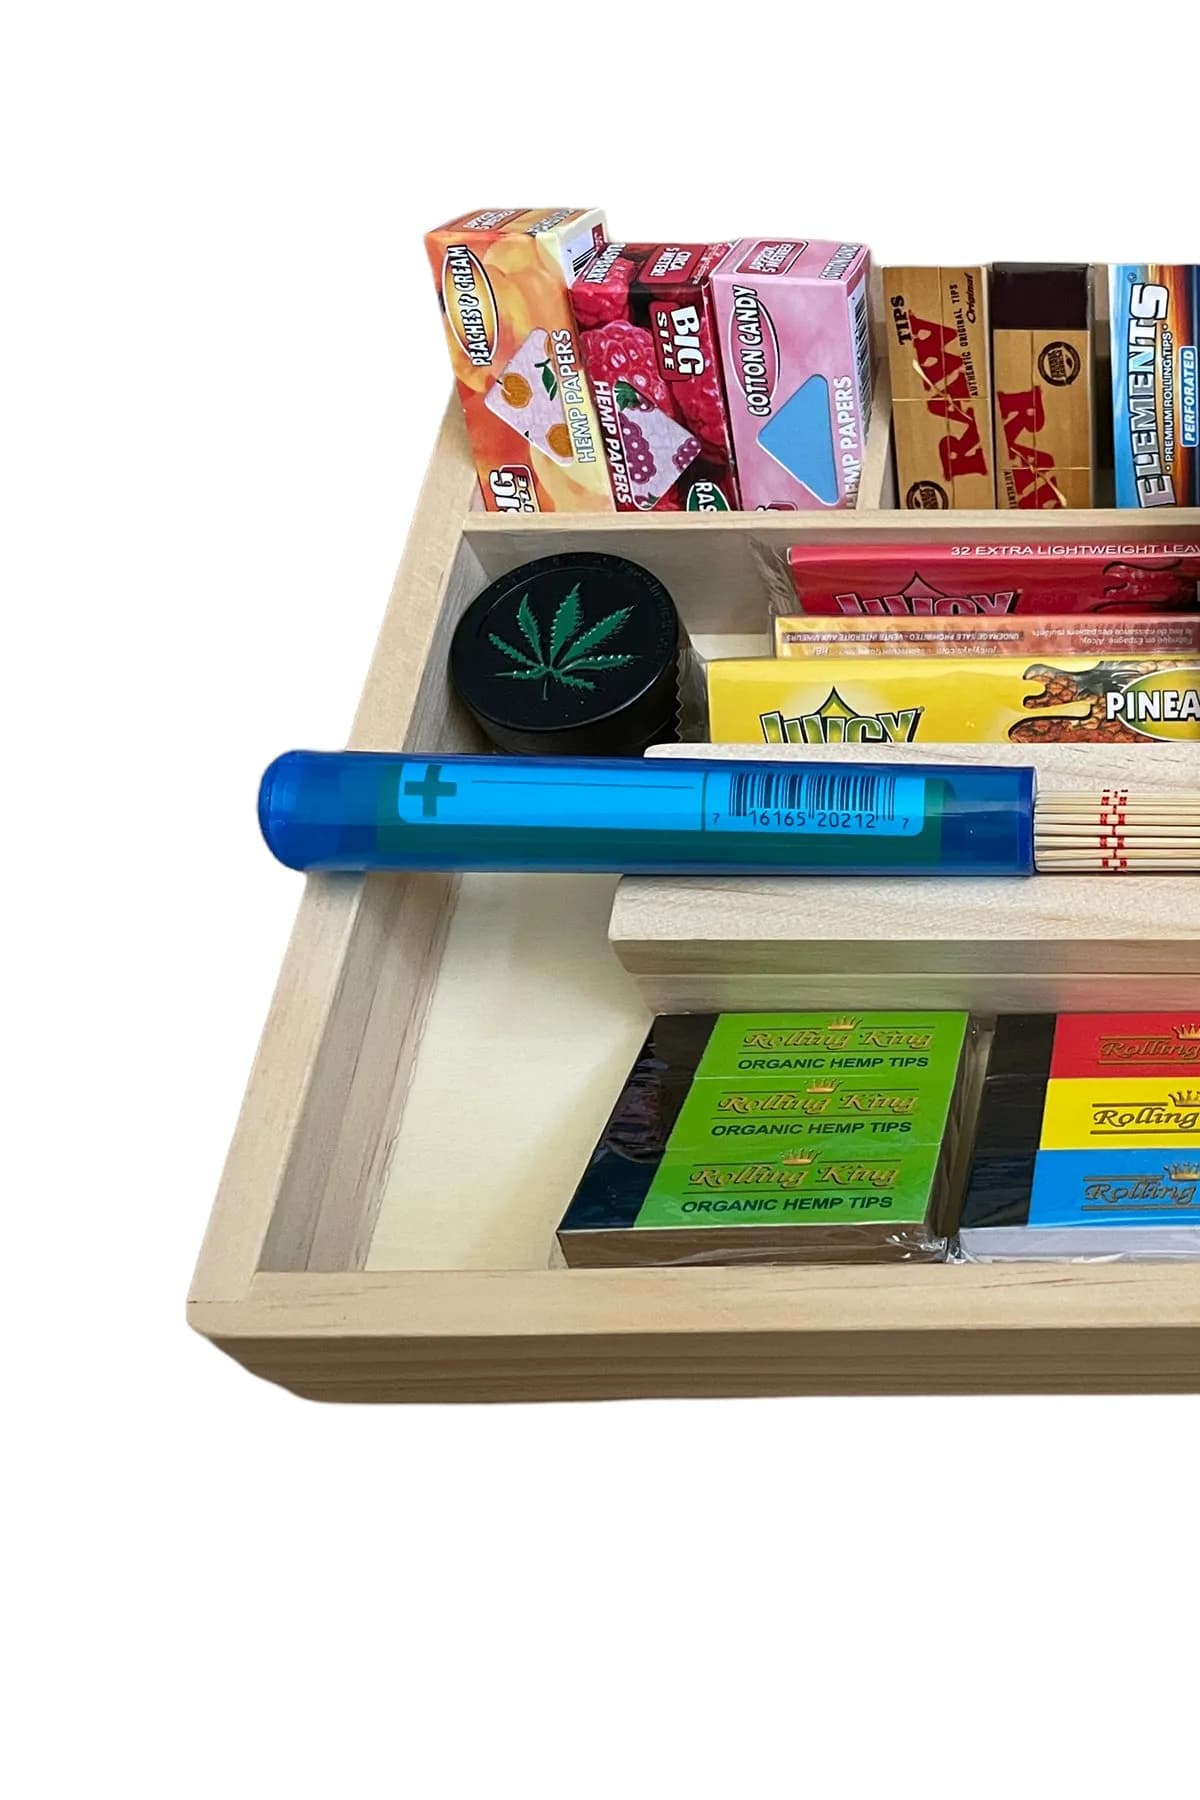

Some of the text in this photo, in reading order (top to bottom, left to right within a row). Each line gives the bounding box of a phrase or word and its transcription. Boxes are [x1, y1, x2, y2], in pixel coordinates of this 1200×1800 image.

[447, 244, 475, 293] CREAM
[890, 294, 913, 346] TIPS
[964, 272, 977, 324] Original
[460, 311, 492, 367] PEACHES
[656, 311, 675, 372] SIZE
[670, 305, 704, 376] BIG
[732, 284, 772, 417] COTTON CANDY
[950, 283, 979, 397] AUTHENTIC ORIGINAL TIPS
[551, 328, 596, 464] HEMP PAPERS
[832, 374, 858, 450] PAPERS
[908, 309, 989, 482] RAW
[1127, 282, 1177, 509] ELEMENTS
[1163, 331, 1175, 462] PREMIUM ROLLING TIPS
[1183, 349, 1196, 443] PERFORATED
[593, 379, 631, 505] HEMP PAPERS
[951, 546, 971, 556] 32
[974, 546, 1034, 556] EXTRA
[1035, 545, 1158, 556] LIGHTWEIGHT
[711, 810, 910, 830] 7 16165 20212 7
[737, 1056, 930, 1070] ORGANIC HEMP TIPS
[743, 1028, 936, 1050] Rolling King
[711, 1120, 912, 1137] ORGANIC HEMP TIPS
[717, 1091, 920, 1114] Rolling King
[1092, 1107, 1200, 1129] Rolling
[688, 1162, 899, 1189] Rolling King
[1084, 1179, 1198, 1205] Rolling
[681, 1195, 894, 1214] ORGANIC HEMP TIPS
